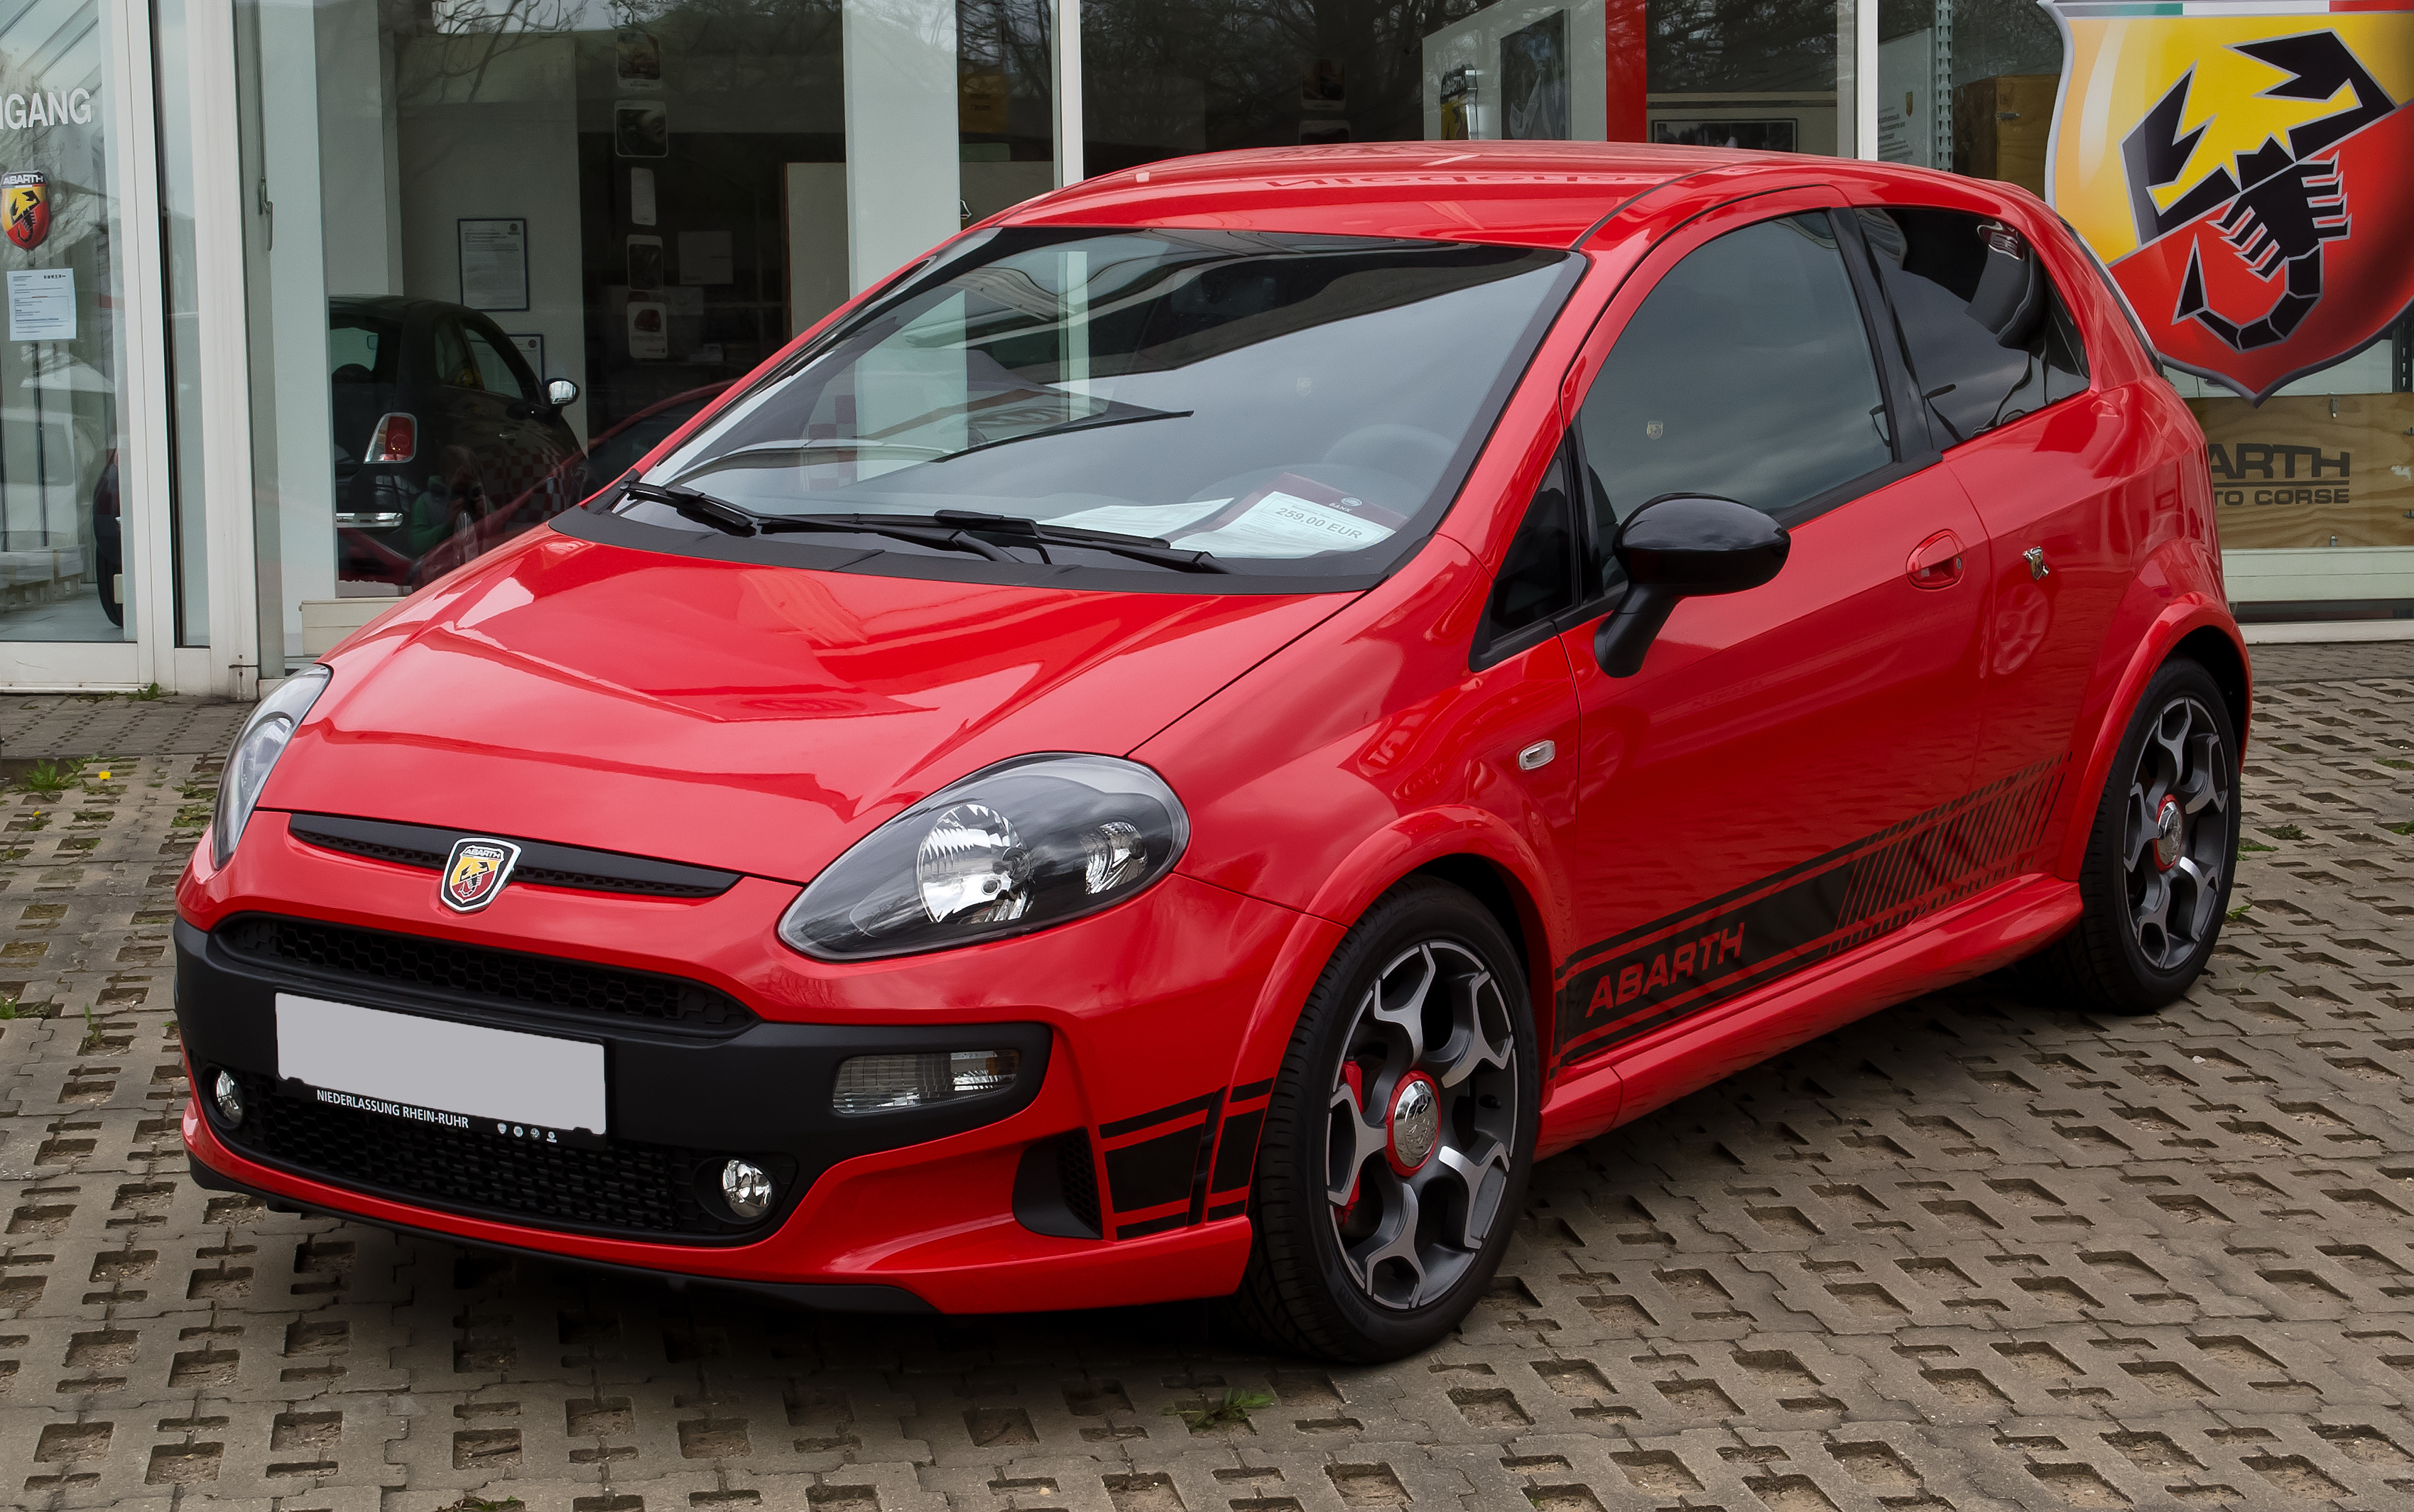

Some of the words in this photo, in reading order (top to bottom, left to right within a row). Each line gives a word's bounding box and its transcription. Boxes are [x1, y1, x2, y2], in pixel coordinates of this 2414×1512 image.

[0, 88, 92, 129] GANG
[4, 174, 44, 185] ABARTH
[2254, 489, 2350, 505] CORSE
[1275, 508, 1326, 527] 259,00
[1327, 523, 1363, 539] EUR
[464, 849, 501, 858] ABARTH
[1585, 923, 1745, 1018] ABARTH
[317, 1089, 400, 1116] NIEDERLASSUNG
[403, 1106, 469, 1128] RHEIN-RUHR
